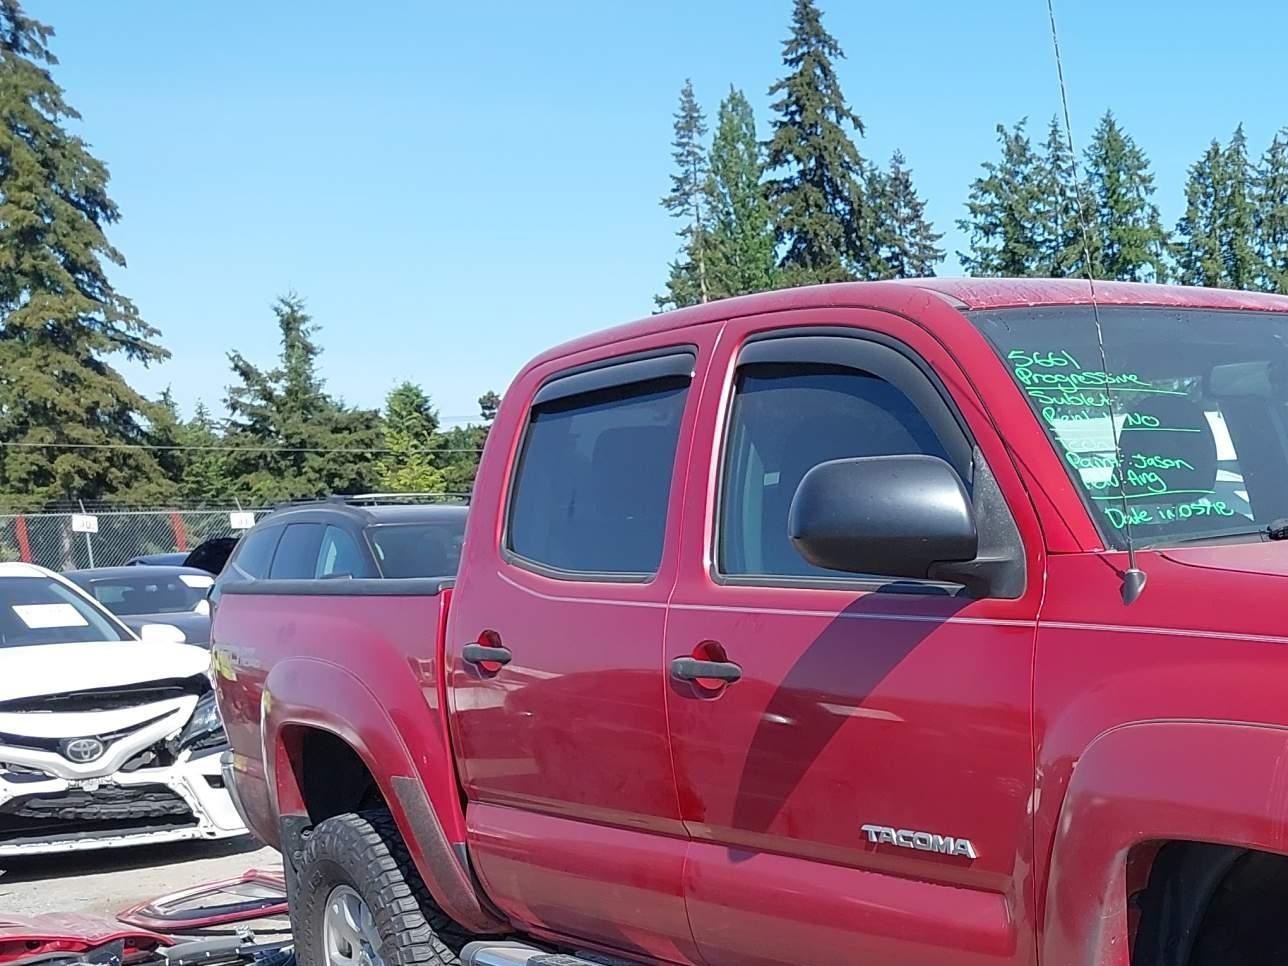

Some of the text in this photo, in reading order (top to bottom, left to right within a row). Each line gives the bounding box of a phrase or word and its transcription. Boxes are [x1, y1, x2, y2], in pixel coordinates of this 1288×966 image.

[1127, 412, 1160, 427] NO
[1104, 506, 1153, 529] Date
[860, 824, 977, 859] TACOMA
